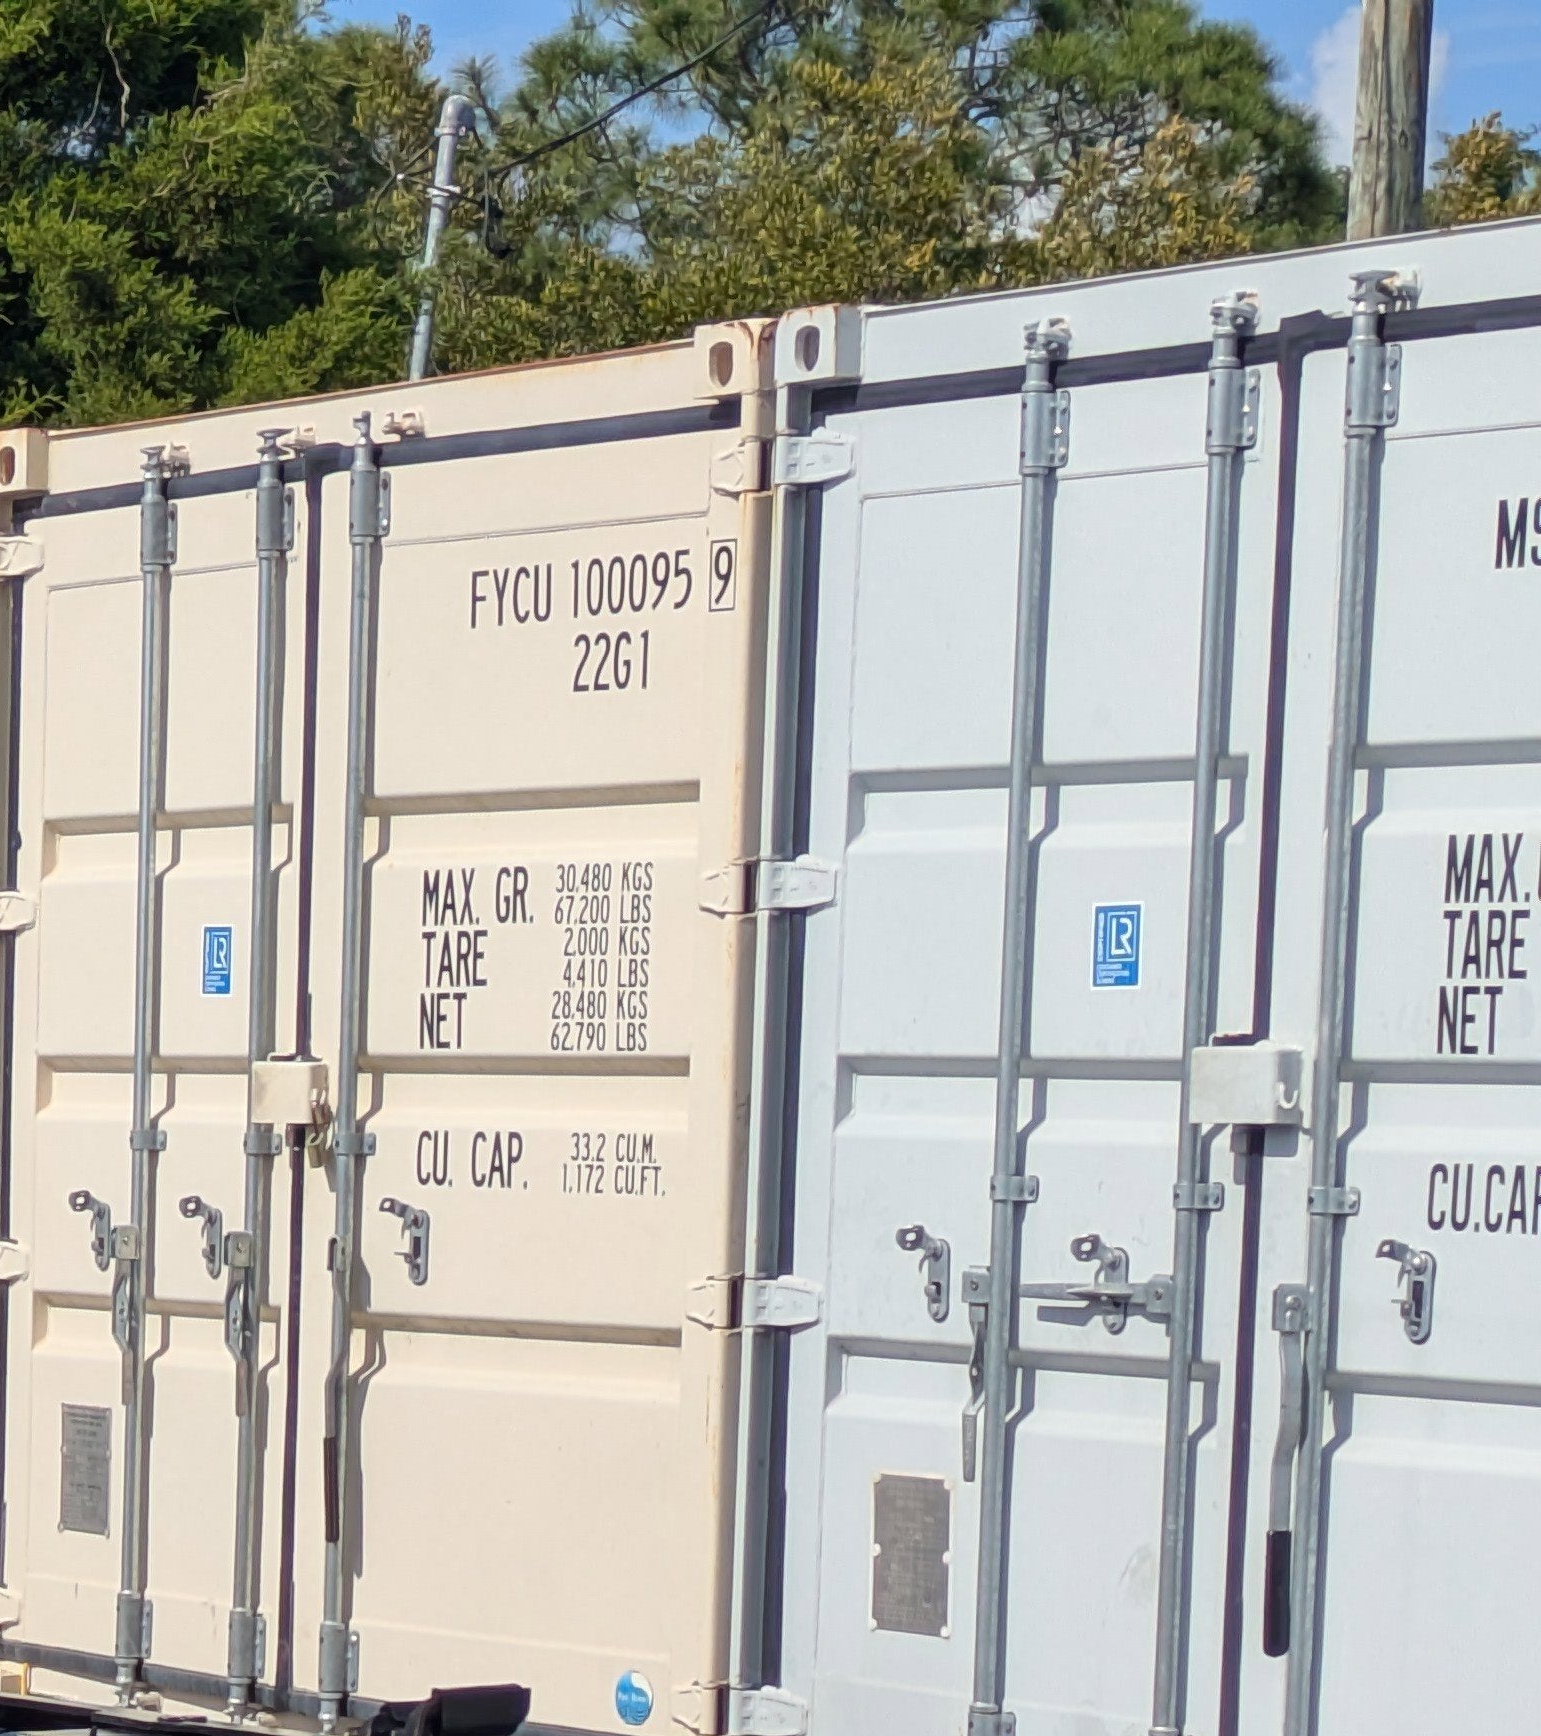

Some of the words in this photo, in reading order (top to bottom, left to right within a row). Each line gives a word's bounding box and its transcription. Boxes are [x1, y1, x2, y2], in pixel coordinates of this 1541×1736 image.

[471, 563, 552, 629] FYCU
[571, 549, 692, 618] 100095
[714, 545, 733, 604] 9
[573, 630, 649, 692] 22G1
[422, 868, 480, 926] MAX.
[495, 866, 534, 924] GR.
[621, 862, 654, 892] KGS
[1444, 832, 1530, 903] MAX.
[619, 894, 652, 924] LBS
[422, 929, 488, 988] TARE
[618, 926, 651, 955] KGS
[1443, 909, 1531, 979] TARE
[617, 958, 649, 988] LBS
[419, 992, 467, 1050] NET
[615, 990, 648, 1020] KGS
[1436, 985, 1503, 1055] NET
[615, 1021, 648, 1051] LBS
[417, 1130, 452, 1187] CU.
[471, 1131, 528, 1189] CAP.
